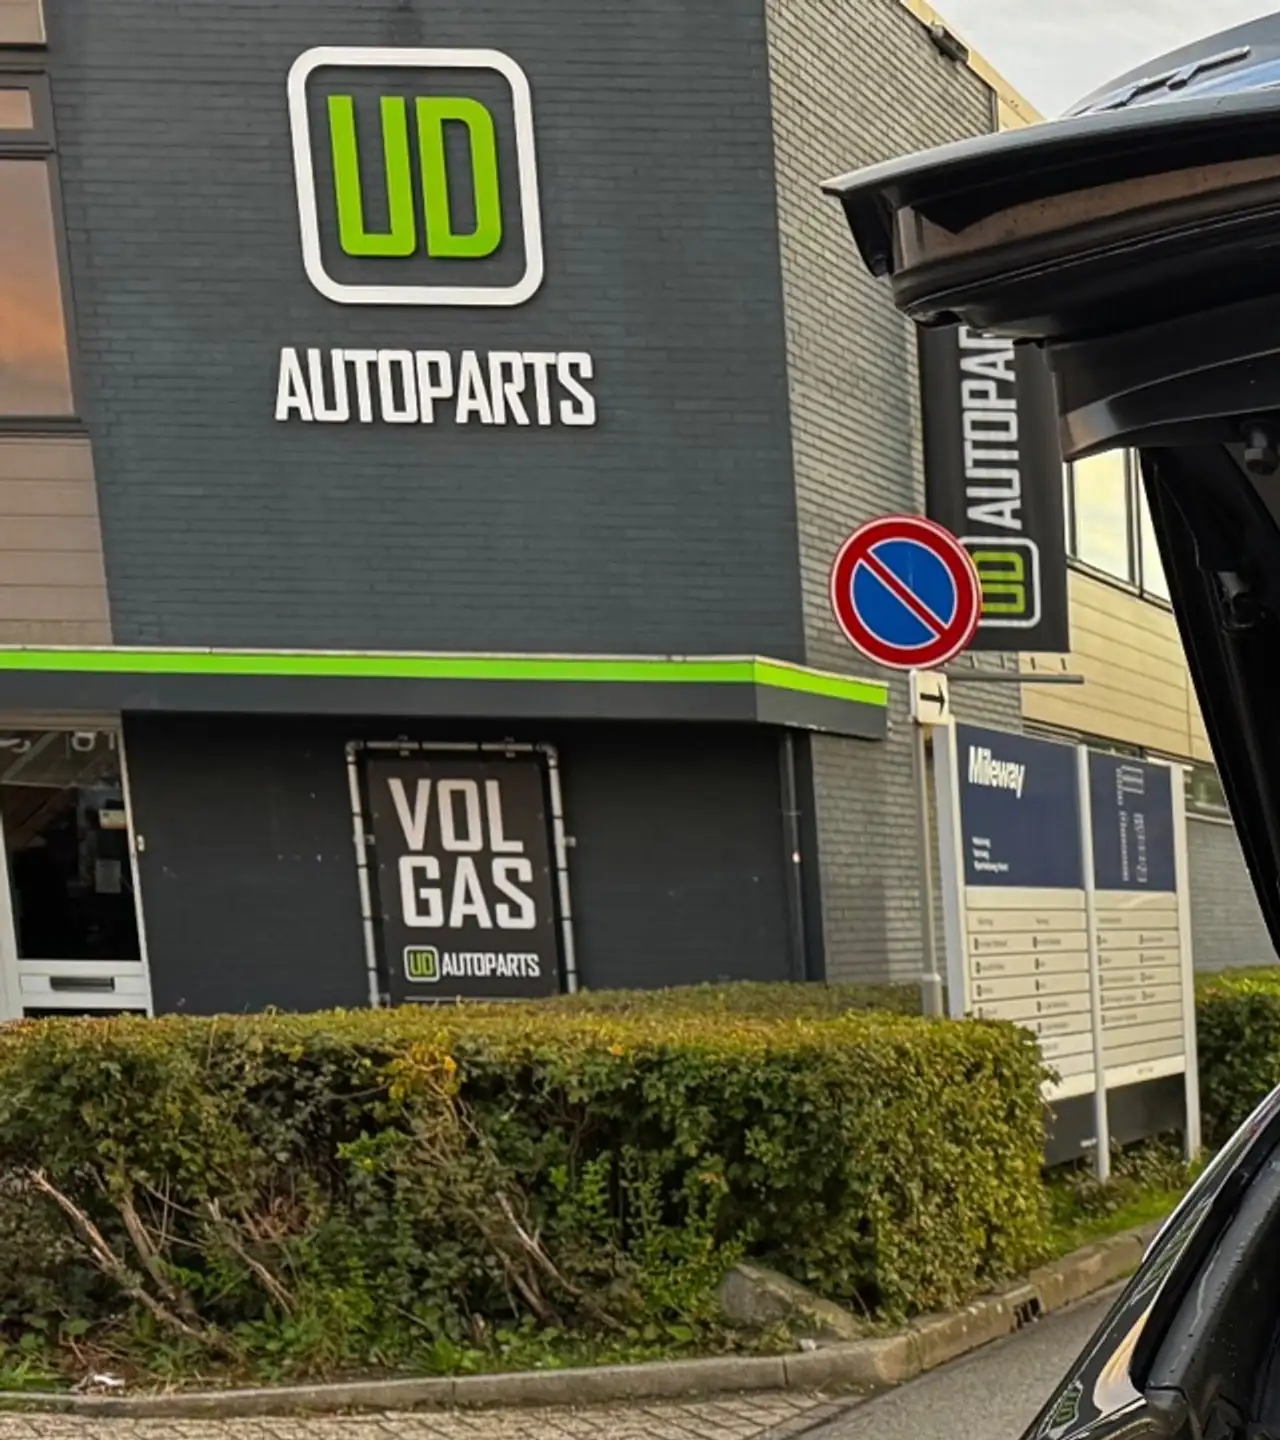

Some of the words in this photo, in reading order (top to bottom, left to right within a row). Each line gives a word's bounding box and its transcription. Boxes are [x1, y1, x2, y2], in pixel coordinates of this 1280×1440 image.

[327, 95, 504, 258] UD
[274, 347, 597, 426] AUTOPARTS
[972, 551, 1025, 613] UD
[968, 745, 1025, 799] Mileway
[387, 778, 524, 853] VOL
[398, 855, 537, 929] GAS
[409, 949, 435, 976] UD
[442, 952, 541, 978] AUTOPARTS
